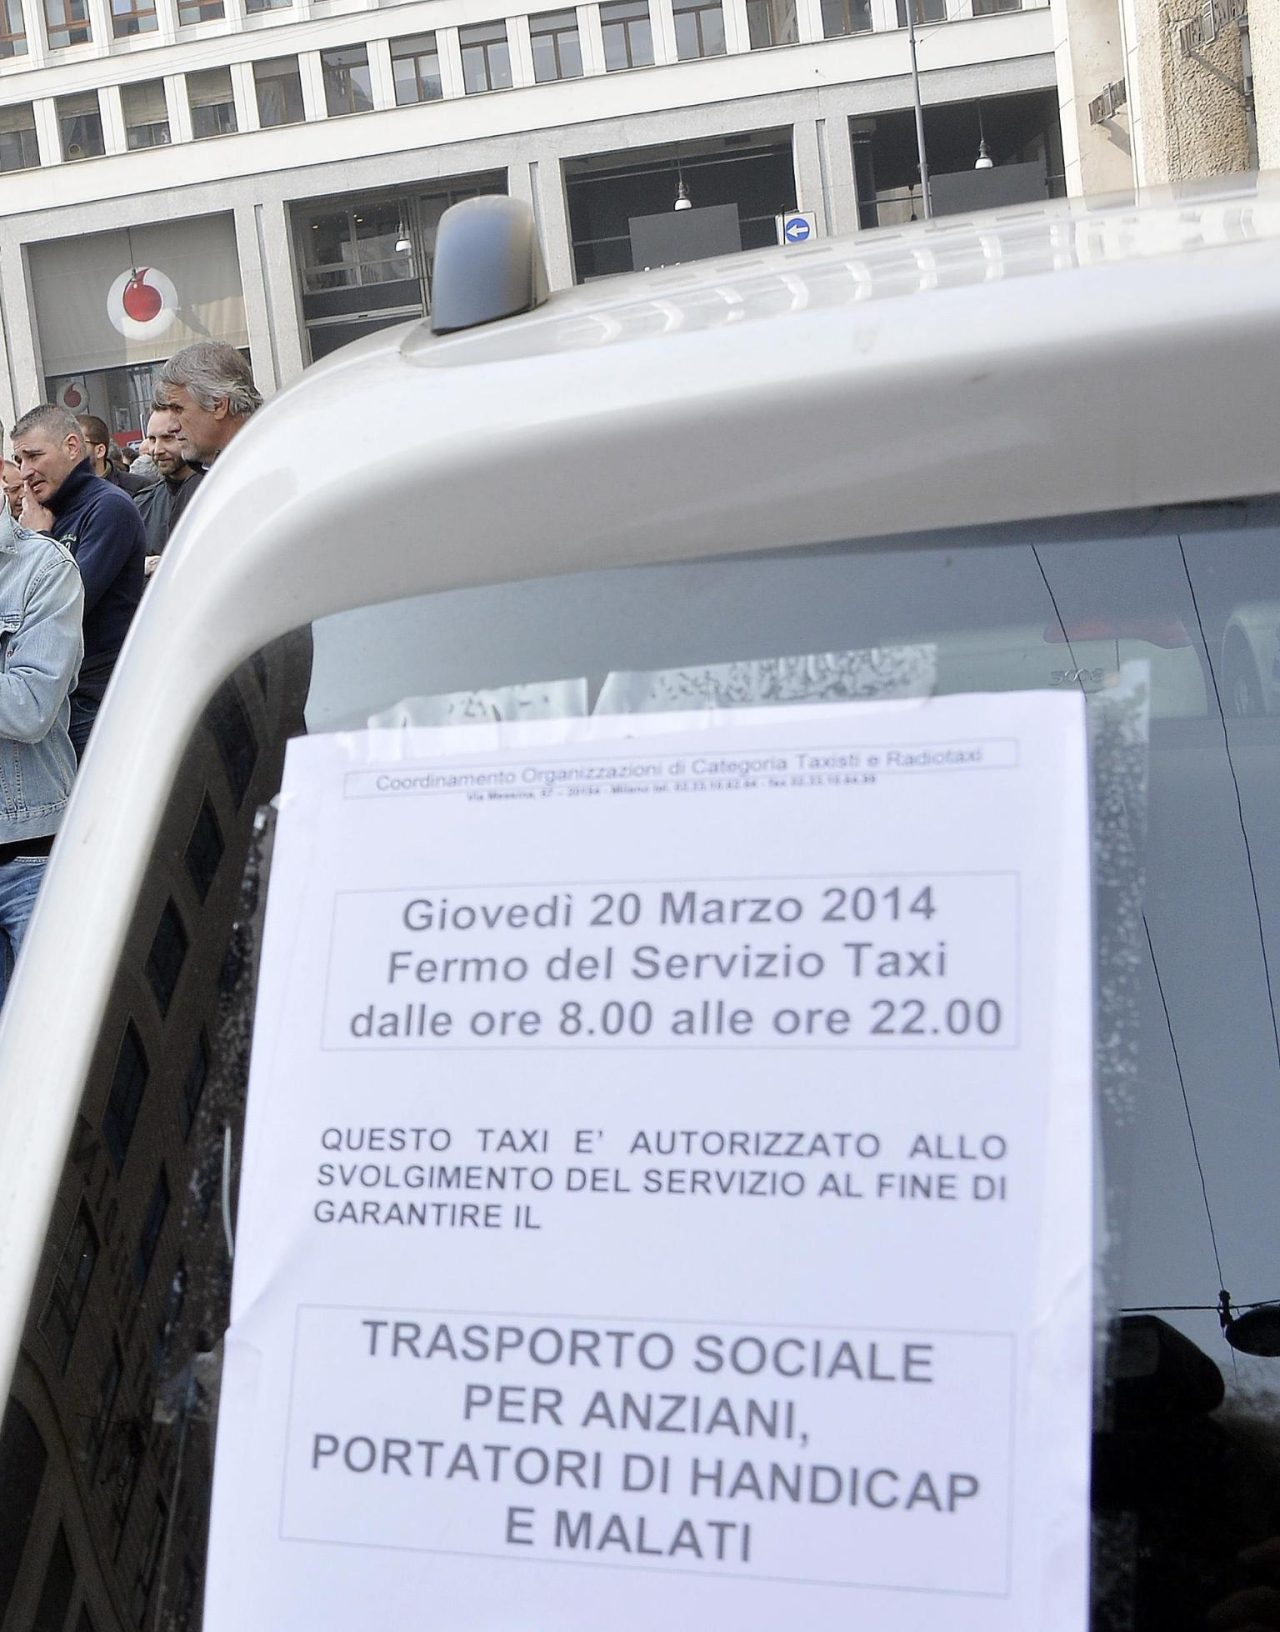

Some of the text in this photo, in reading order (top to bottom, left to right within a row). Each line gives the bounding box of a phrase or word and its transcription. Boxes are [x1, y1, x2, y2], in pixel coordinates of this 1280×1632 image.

[376, 749, 983, 790] Coordinamento Organizzazioni di Categoria Taxisti e Radiotaxi
[403, 886, 936, 932] Giovedì 20 Marzo 2014
[388, 941, 946, 984] Fermo del Servizio Taxi
[350, 998, 1002, 1038] dalle ore 8.00 alle ore 22.00
[321, 1128, 1007, 1161] QUESTO TAXI E' AUTORIZZATO ALLO
[318, 1163, 1006, 1201] SVOLGIMENTO DEL SERVIZIO AL FINE DI
[314, 1200, 541, 1229] GARANTIRE IL
[362, 1320, 934, 1384] TRASPORTO SOCIALE
[464, 1384, 808, 1448] PER ANZIANI,
[312, 1433, 980, 1513] PORTATORI DI HANDICAP
[506, 1506, 750, 1562] E MALATI
